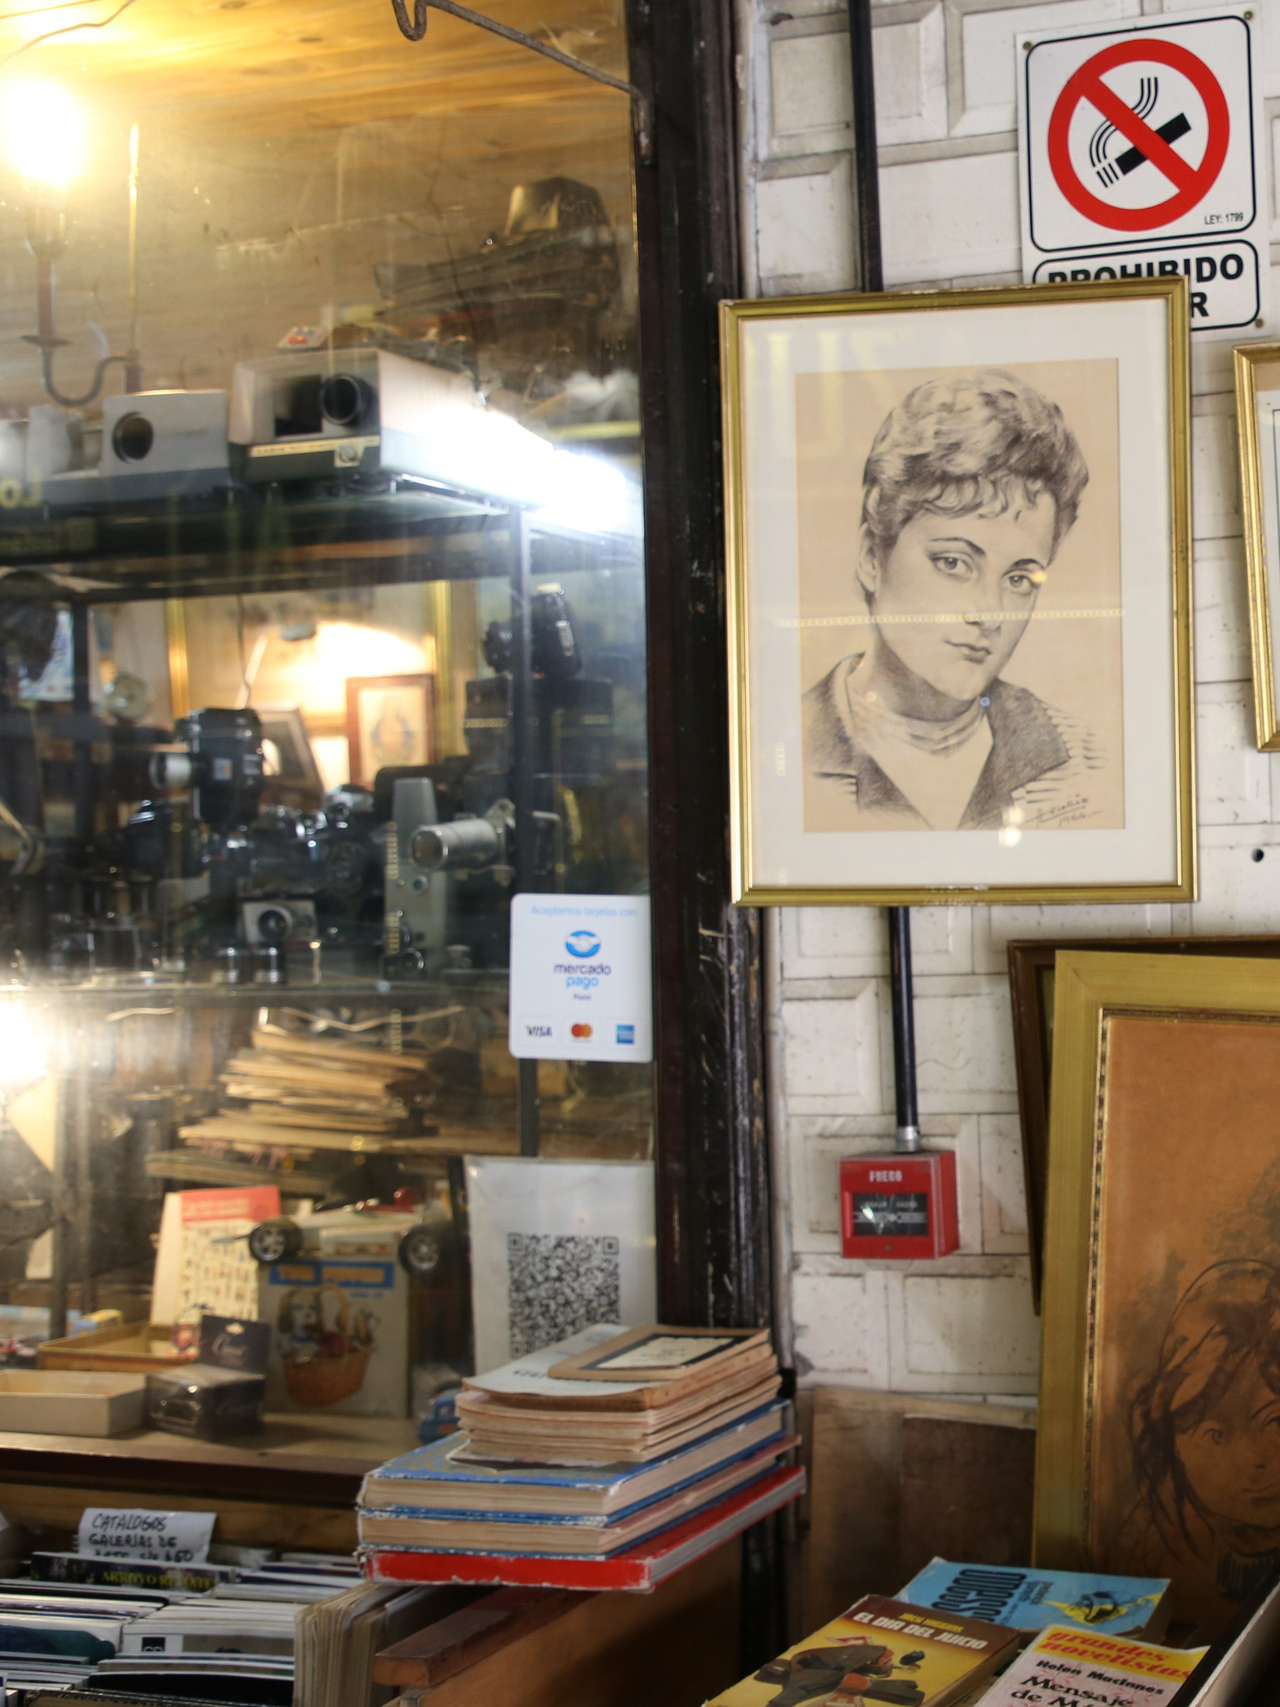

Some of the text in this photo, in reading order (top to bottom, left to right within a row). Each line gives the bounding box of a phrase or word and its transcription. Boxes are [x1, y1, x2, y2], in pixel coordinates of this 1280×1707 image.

[1204, 214, 1223, 226] LEY:
[553, 963, 612, 976] mercado
[566, 975, 600, 991] pago
[526, 1025, 553, 1038] VISA
[852, 1611, 989, 1650] EL DIA DEL JUICIO
[1046, 1632, 1170, 1662] grandes
[1011, 1689, 1043, 1703] de
[1020, 1675, 1133, 1707] Mensaje
